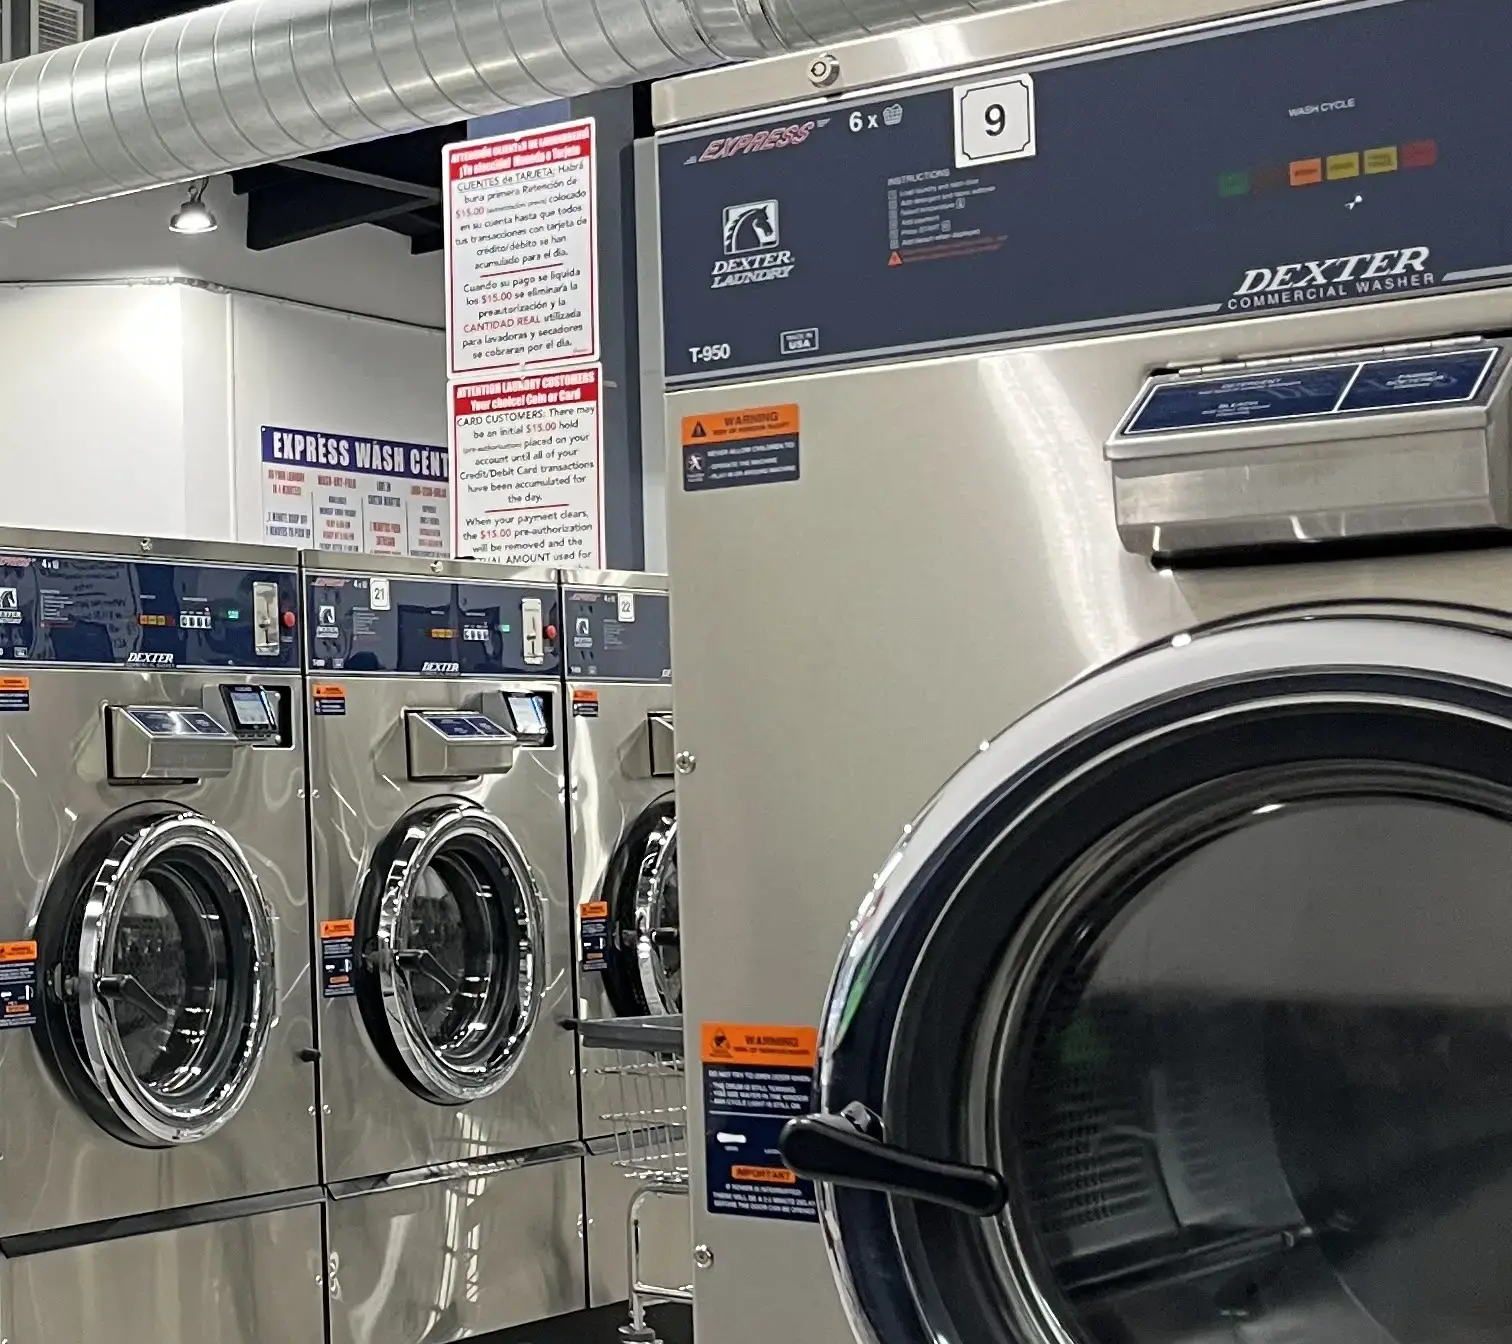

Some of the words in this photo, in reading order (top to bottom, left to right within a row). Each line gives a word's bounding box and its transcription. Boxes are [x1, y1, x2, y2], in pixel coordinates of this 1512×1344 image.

[1289, 106, 1319, 117] WASH
[1321, 98, 1355, 112] CYCLE
[849, 111, 863, 132] 6
[867, 115, 878, 129] x
[985, 104, 1006, 136] 9
[698, 121, 816, 163] EXPRESS
[503, 174, 512, 184] de
[523, 180, 564, 194] Retención
[567, 178, 577, 186] de
[456, 206, 484, 219] $15.00
[549, 190, 586, 203] colocado
[485, 218, 513, 228] cuenta
[515, 212, 536, 222] hasta
[540, 210, 555, 219] que
[558, 205, 582, 215] todos
[529, 226, 544, 234] con
[547, 220, 574, 233] tarjeta
[577, 217, 587, 225] de
[551, 235, 566, 243] han
[475, 256, 519, 270] acumulado
[522, 253, 541, 264] para
[544, 249, 551, 259] el
[711, 250, 791, 275] DEXTER
[711, 265, 794, 288] LAUNDRY
[1233, 246, 1430, 296] DEXTER
[464, 279, 497, 293] Cuando
[512, 276, 535, 288] pago
[538, 274, 548, 282] se
[1227, 283, 1347, 311] COMMERCIAL
[1356, 273, 1435, 293] WASHER
[466, 297, 478, 305] los
[482, 291, 512, 304] $15.00
[571, 282, 578, 290] la
[550, 301, 555, 309] y
[558, 297, 566, 306] la
[464, 319, 514, 333] CANTIDAD
[517, 316, 541, 326] REAL
[462, 338, 482, 349] para
[485, 331, 527, 344] lavadoras
[530, 332, 535, 340] y
[485, 346, 524, 358] cobraran
[528, 343, 543, 353] por
[546, 340, 553, 350] el
[689, 344, 730, 363] T-950
[457, 382, 501, 399] ATTENTION
[548, 392, 558, 402] or
[559, 389, 581, 401] Card
[457, 415, 482, 427] CARD
[549, 406, 574, 417] There
[577, 406, 594, 416] may
[724, 412, 778, 426] WARNING
[474, 429, 484, 438] be
[500, 425, 523, 436] initial
[526, 421, 557, 433] $15.00
[559, 419, 579, 428] hold
[524, 436, 552, 448] placed
[569, 434, 589, 445] your
[273, 431, 349, 467] EXPRESS
[355, 441, 405, 473] WASH
[475, 456, 508, 466] account
[511, 452, 530, 462] until
[533, 450, 543, 459] all
[546, 449, 555, 458] of
[557, 449, 578, 460] your
[517, 466, 537, 474] Card
[540, 461, 594, 473] transactions
[467, 484, 488, 493] have
[491, 482, 512, 491] been
[515, 476, 570, 489] accumulated
[573, 474, 586, 483] for
[508, 495, 522, 503] the
[466, 516, 491, 526] When
[494, 517, 514, 526] your
[518, 512, 557, 525] payment
[463, 532, 477, 540] the
[480, 529, 511, 539] $15.00
[514, 524, 592, 539] pre-authorization
[473, 543, 488, 553] will
[491, 543, 502, 552] be
[504, 540, 545, 551] removed
[548, 539, 565, 547] and
[568, 538, 582, 546] the
[506, 552, 550, 564] AMOUNT
[554, 551, 574, 560] used
[578, 550, 592, 559] for
[374, 588, 385, 600] 21
[621, 601, 630, 612] 22
[128, 652, 174, 663] DEXTER
[422, 661, 460, 672] DEXTER
[744, 1035, 798, 1047] WARNING
